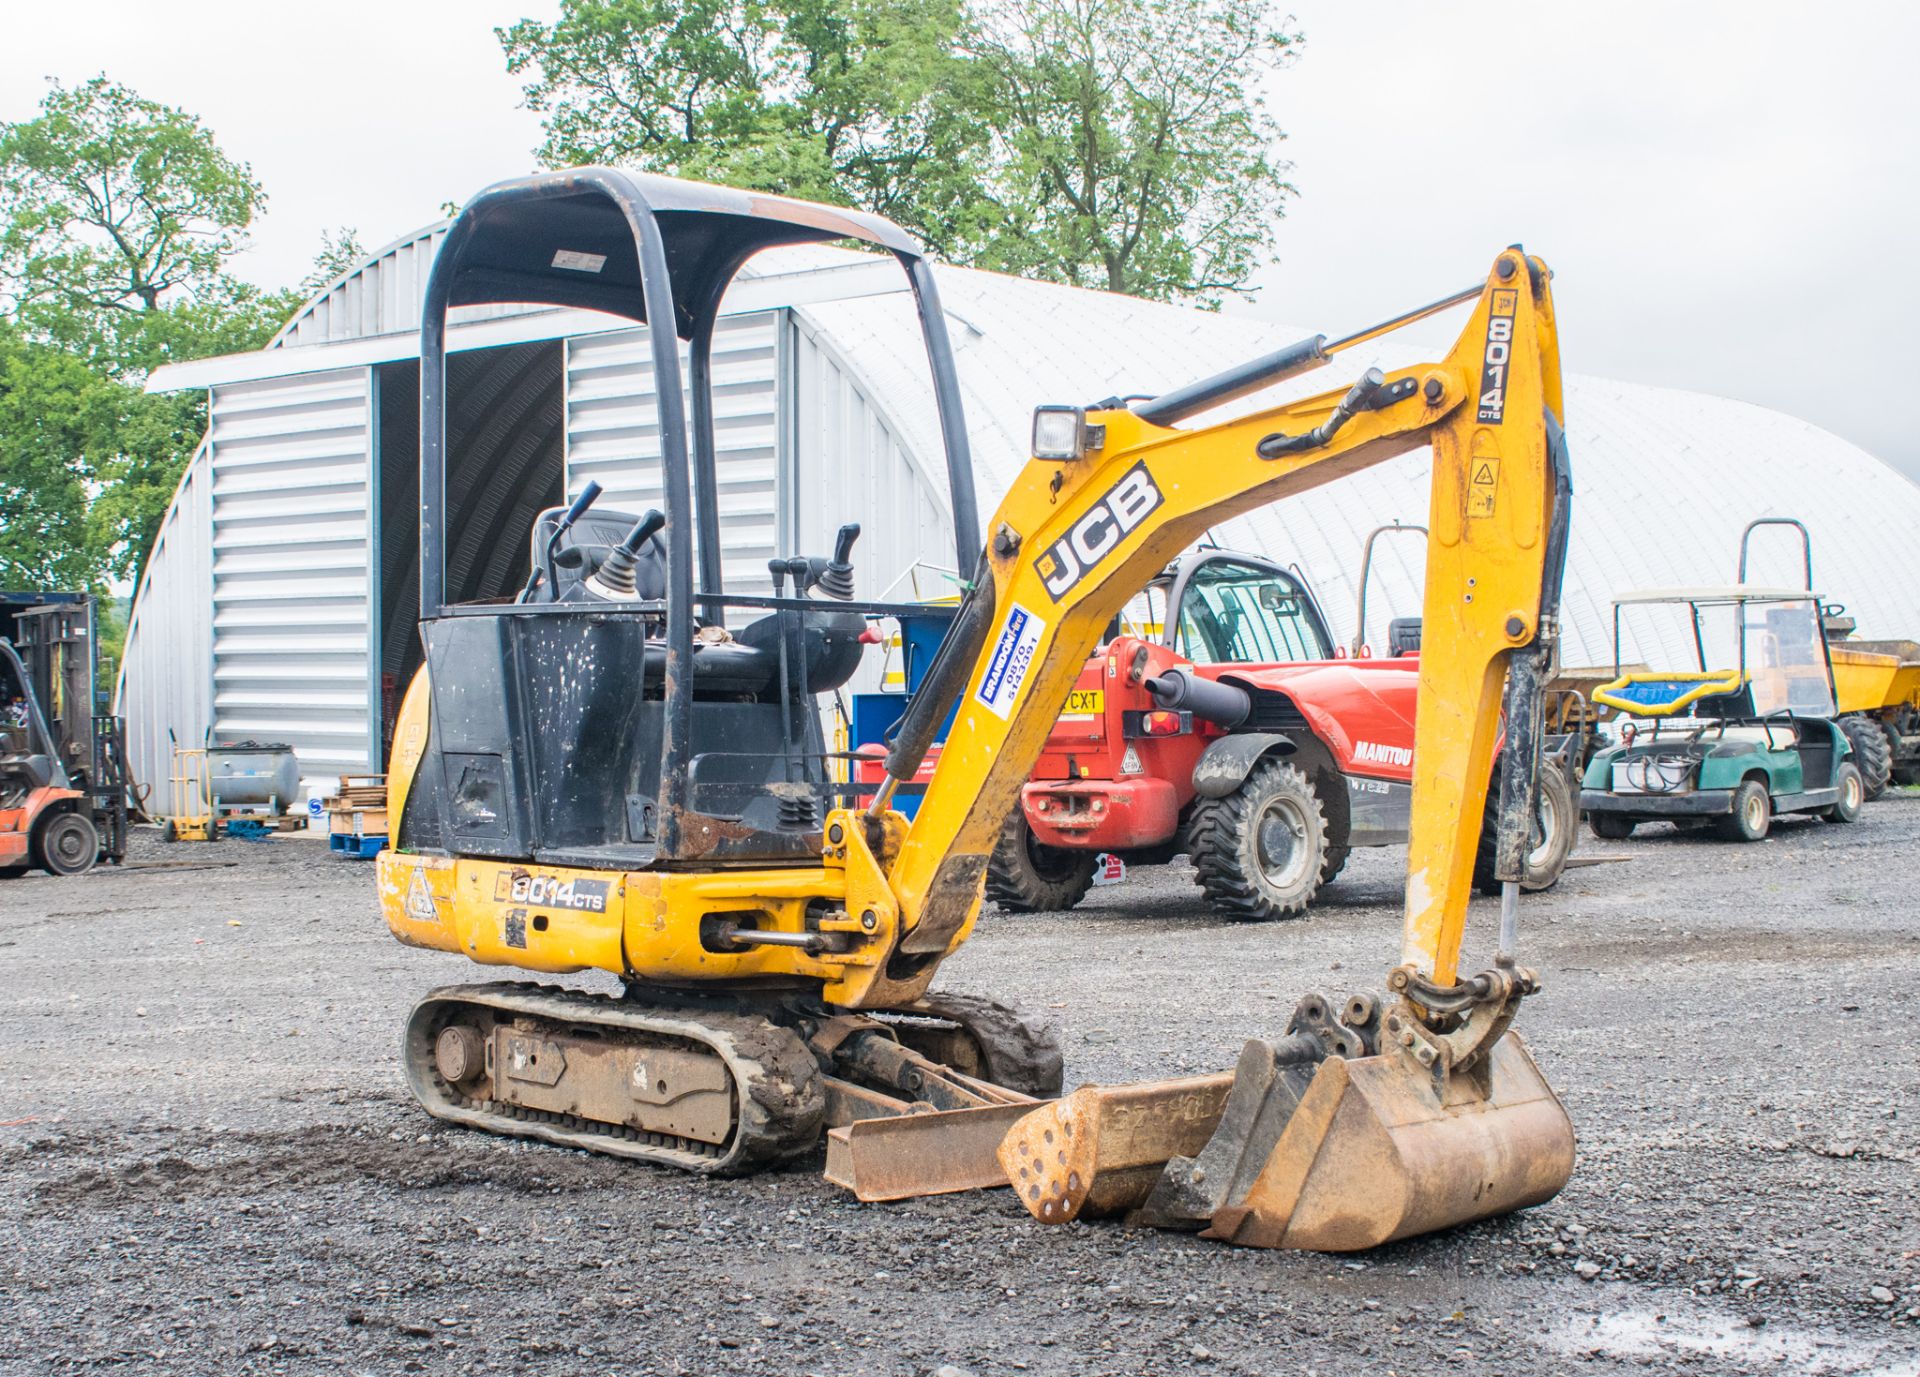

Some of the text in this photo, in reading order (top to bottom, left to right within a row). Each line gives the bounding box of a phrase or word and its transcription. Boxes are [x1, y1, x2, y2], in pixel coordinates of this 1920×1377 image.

[1046, 470, 1158, 596] JCB
[984, 630, 1017, 699] BRANDON
[1006, 645, 1026, 684] 0870
[1007, 637, 1038, 700] 5143391
[1354, 740, 1413, 767] MANITOU
